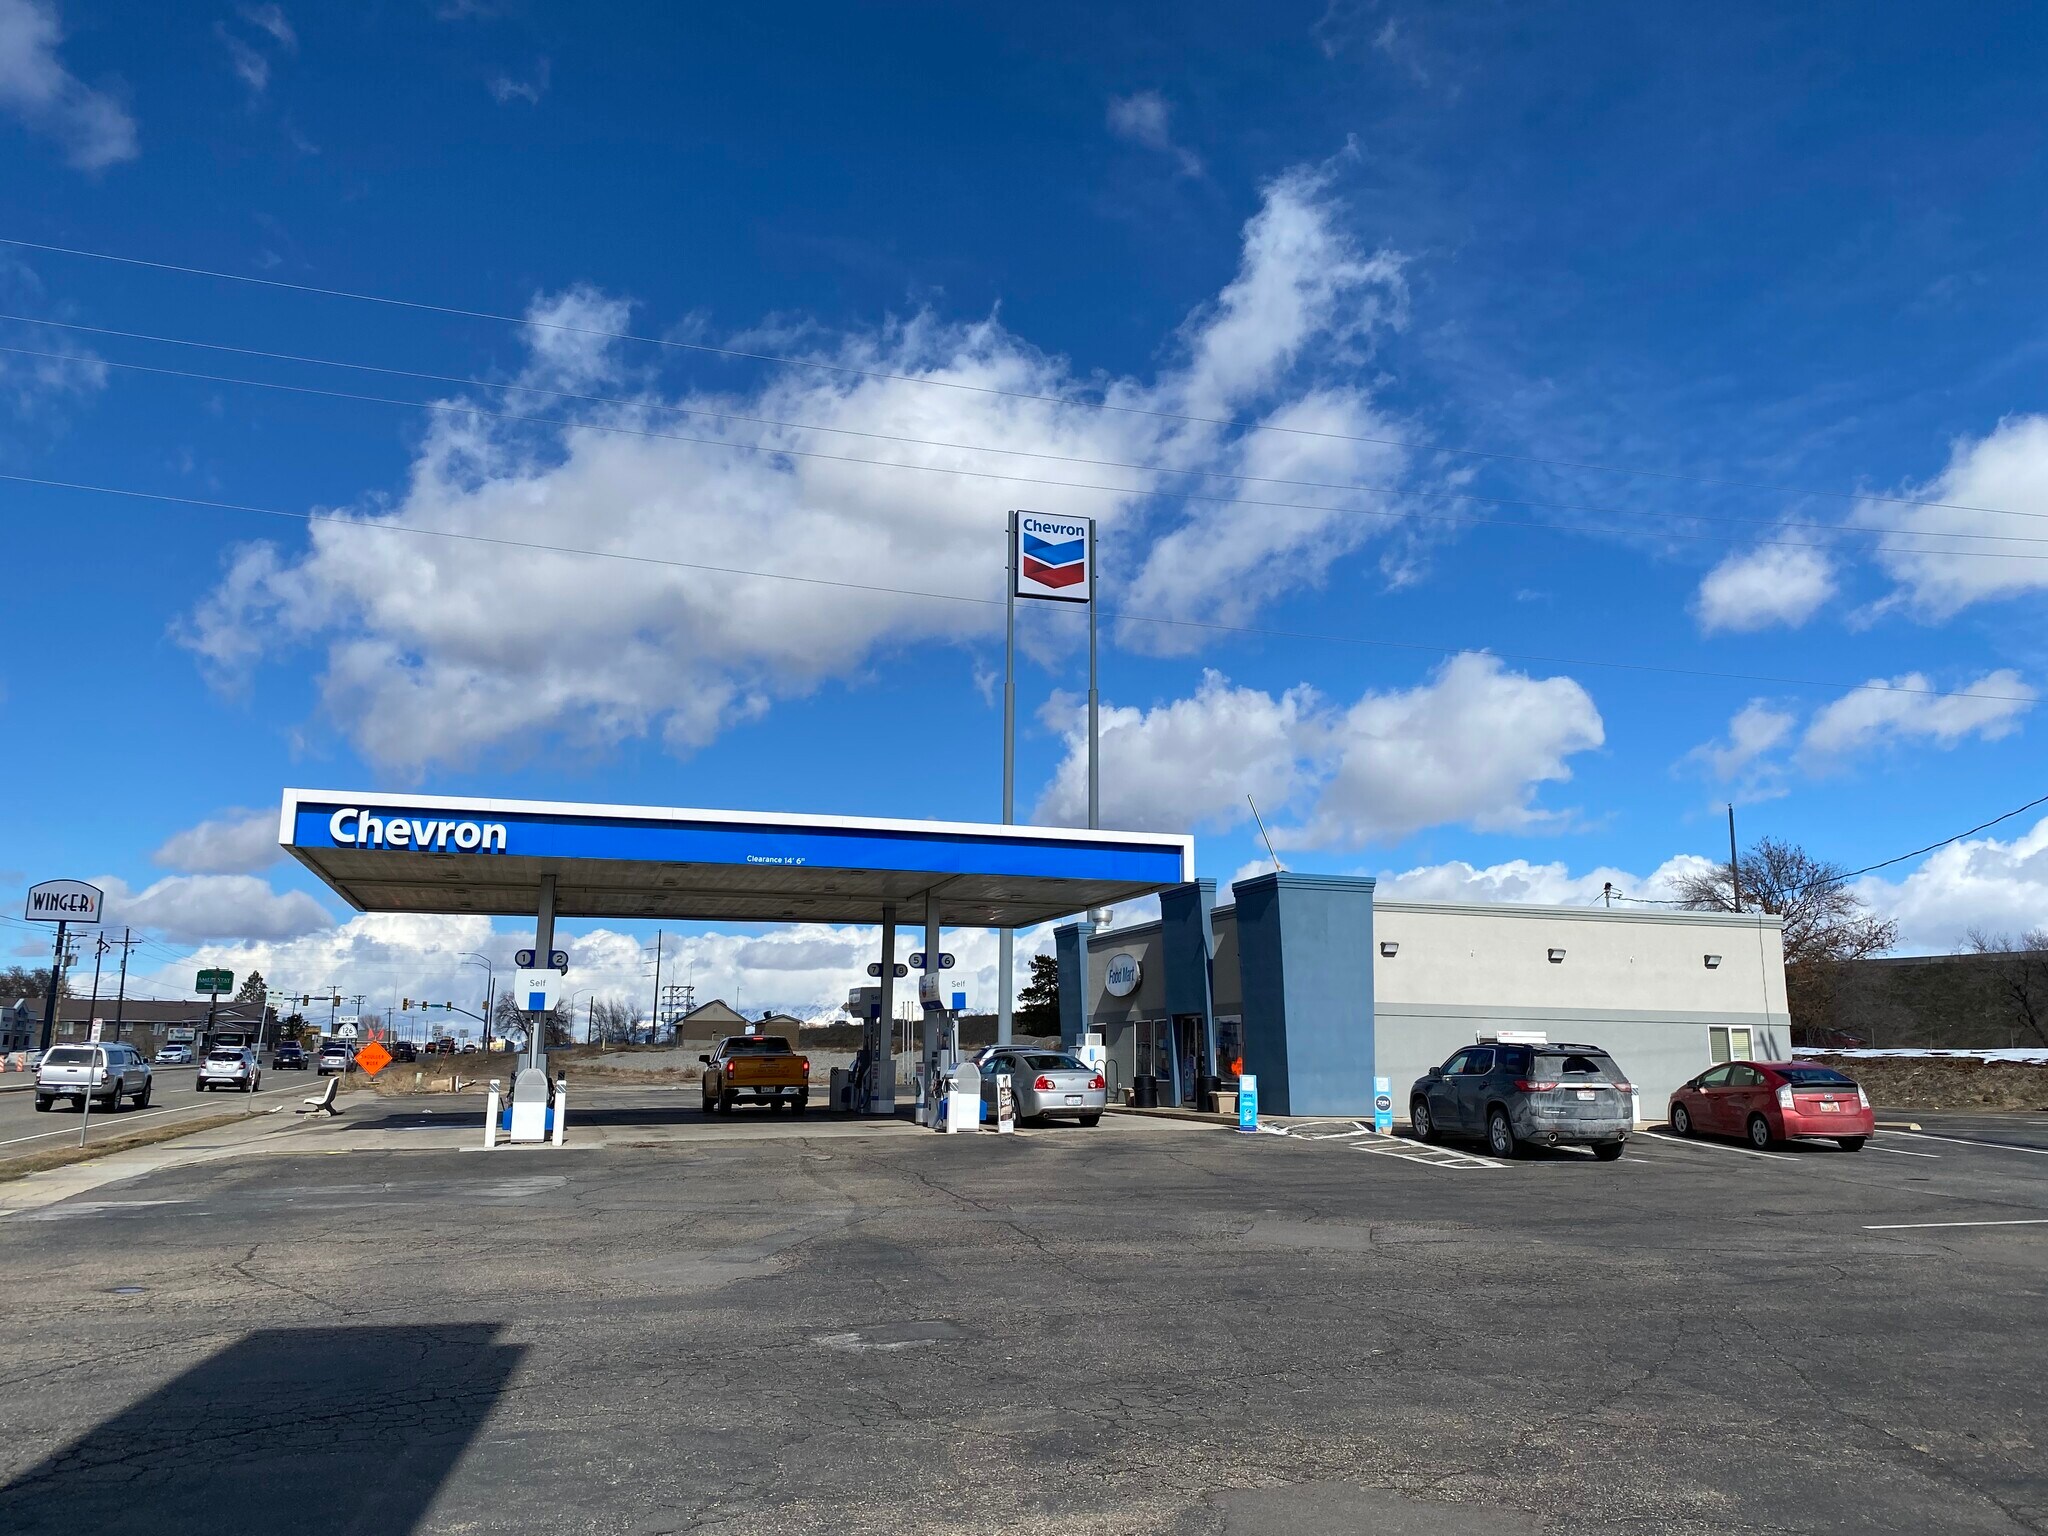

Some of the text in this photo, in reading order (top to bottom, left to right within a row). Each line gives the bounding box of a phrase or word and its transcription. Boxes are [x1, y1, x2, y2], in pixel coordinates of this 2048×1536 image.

[1023, 518, 1085, 537] Chevron
[329, 808, 507, 850] Chevron
[746, 854, 783, 864] Clearance
[521, 953, 526, 962] 1
[556, 954, 563, 963] 2
[913, 956, 920, 964] 5
[944, 956, 951, 964] 6
[871, 966, 877, 974] 7
[899, 966, 905, 974] 8
[1108, 966, 1135, 984] Food Mart
[529, 979, 546, 987] Self
[951, 980, 966, 988] Self
